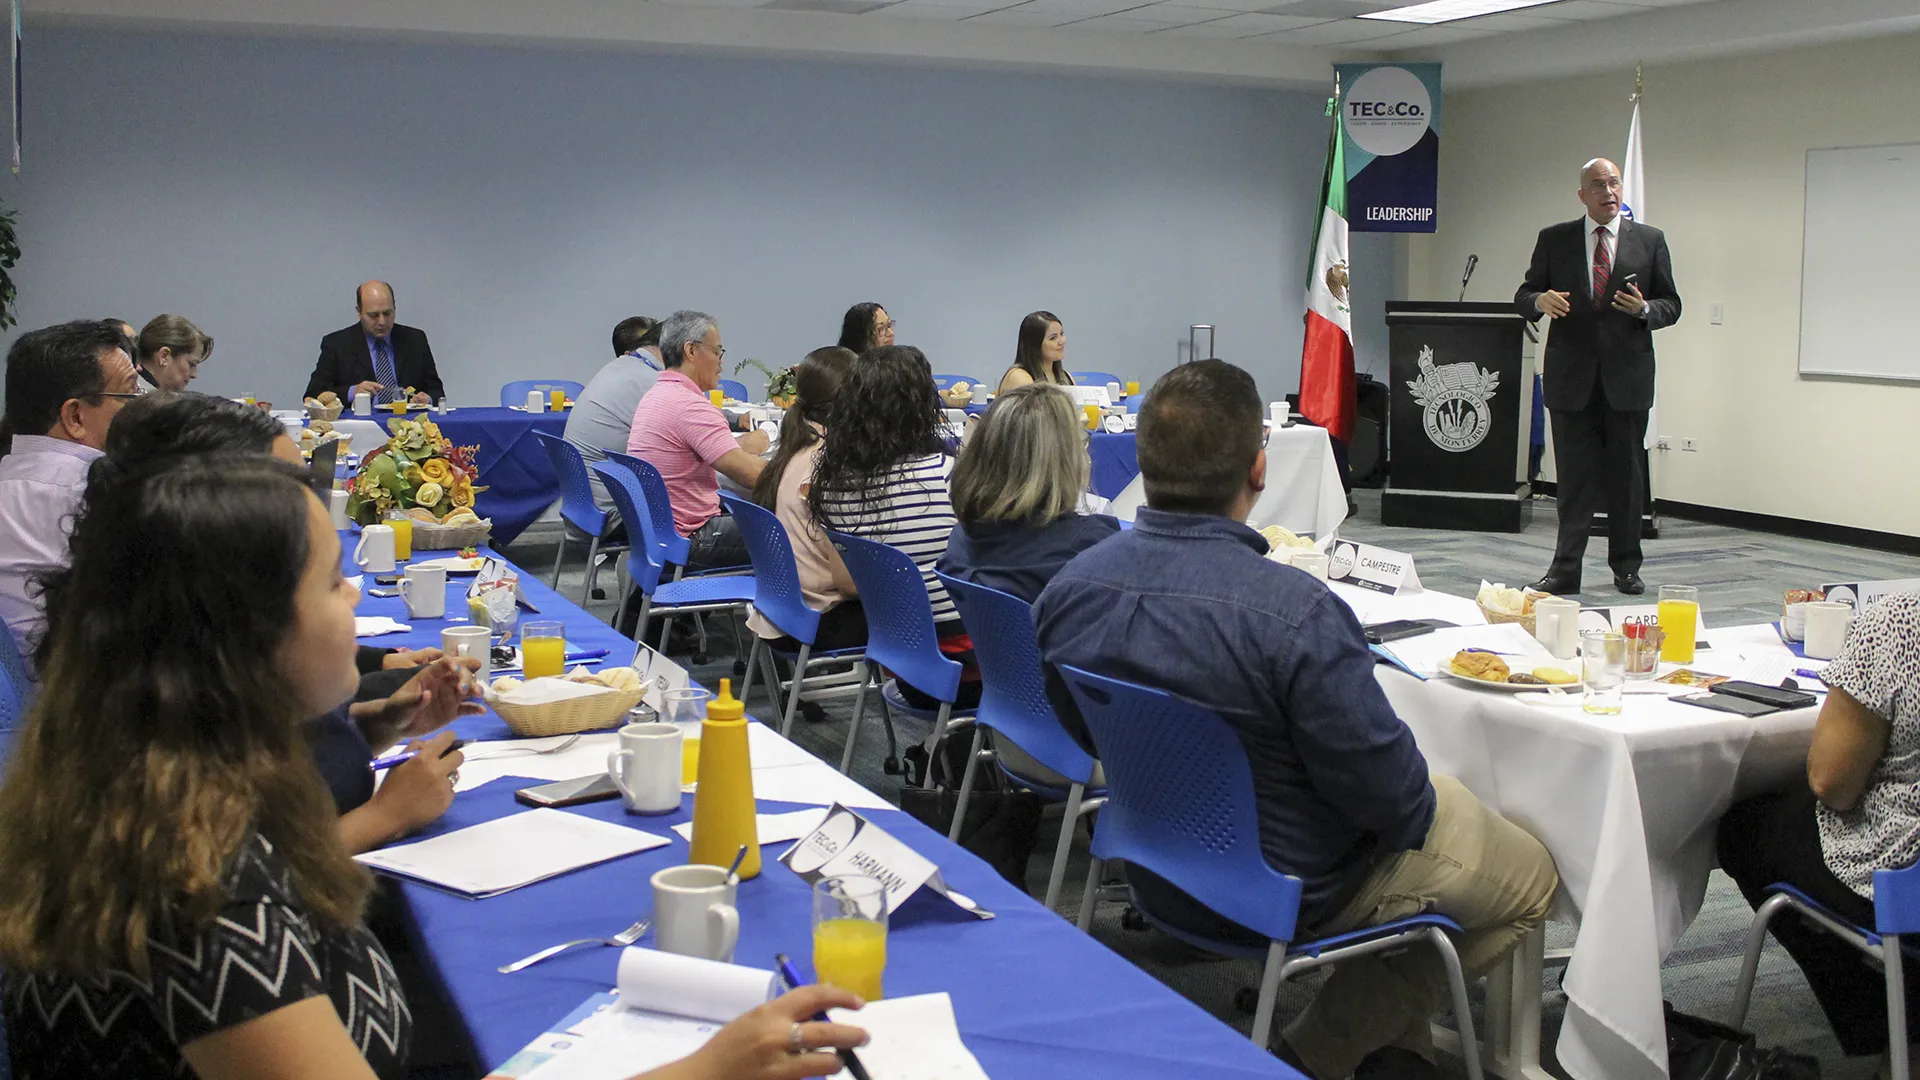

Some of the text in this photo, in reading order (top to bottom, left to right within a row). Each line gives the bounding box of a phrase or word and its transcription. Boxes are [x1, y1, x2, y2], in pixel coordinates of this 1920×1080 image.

[1349, 101, 1424, 117] TEC&Co.
[1366, 206, 1433, 222] LEADERSHIP
[1429, 418, 1486, 447] DE MONTERREY
[1360, 557, 1402, 576] CAMPESTRE
[848, 850, 907, 894] HARMANN
